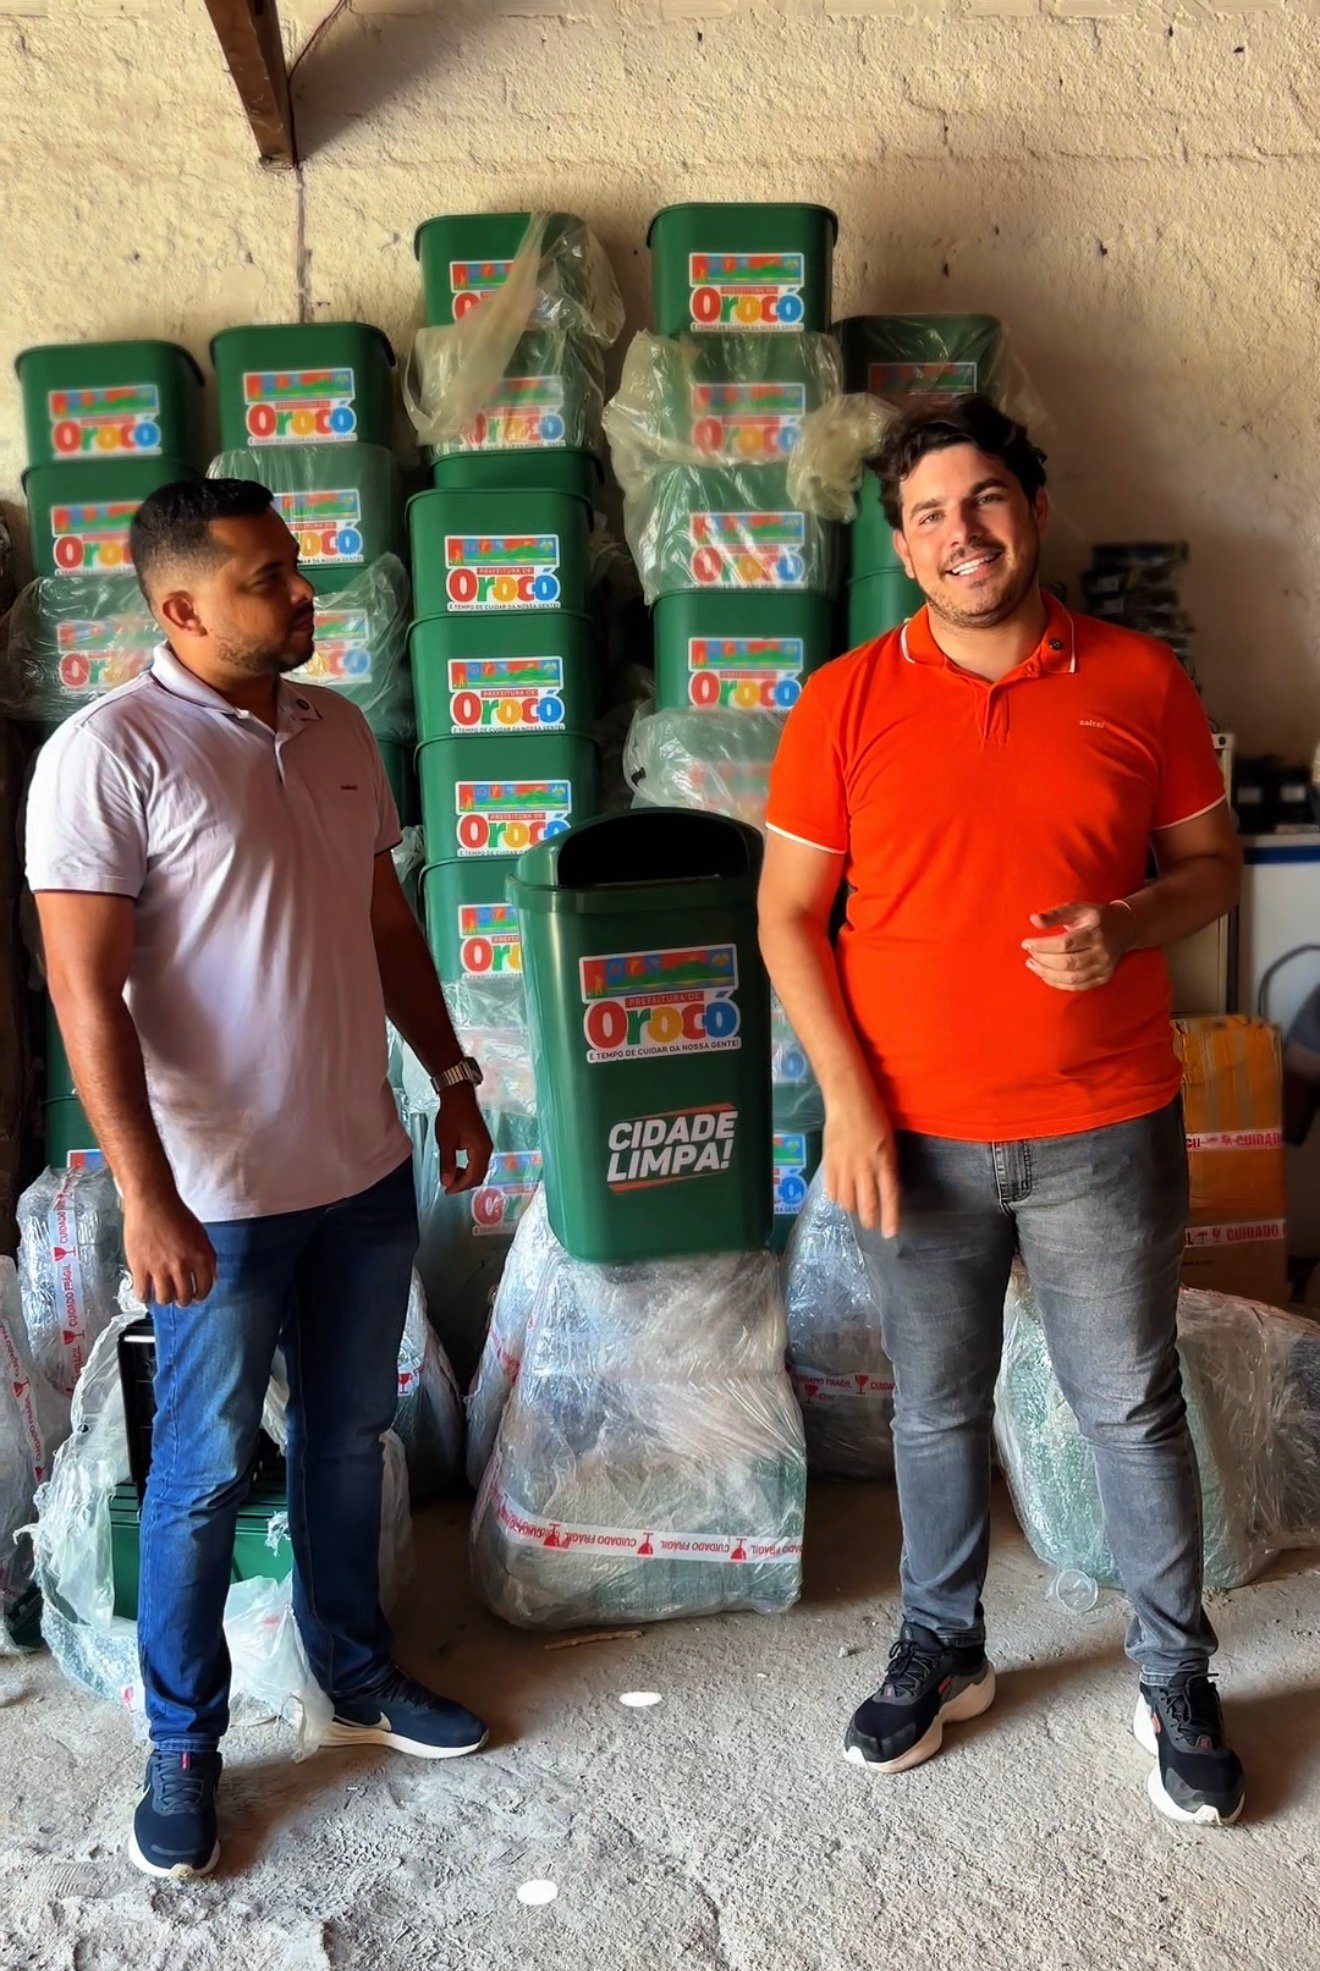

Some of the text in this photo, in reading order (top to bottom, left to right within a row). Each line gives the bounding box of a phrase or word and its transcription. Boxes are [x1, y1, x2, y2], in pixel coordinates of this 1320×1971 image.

[692, 287, 802, 323] Orocó
[54, 415, 159, 453] Orocó
[248, 399, 354, 437] Orocó
[449, 567, 558, 602] Orocó
[453, 689, 562, 725] Orocó
[691, 671, 801, 708] Orocó
[628, 992, 700, 1006] PREFEITURA DE
[587, 990, 737, 1049] Orocó
[596, 1050, 625, 1060] TEMPO
[626, 1049, 636, 1058] DE
[638, 1046, 668, 1056] CUIDAR
[669, 1045, 680, 1053] DA
[682, 1043, 710, 1052] NOSSA
[711, 1039, 739, 1049] GENTE!
[608, 1111, 738, 1151] CIDADE
[606, 1139, 734, 1182] LIMPA!
[1226, 1224, 1280, 1242] CUIDADO
[63, 1292, 78, 1328] CUIDADO
[565, 1532, 637, 1547] CUIDADO FRÁGIL
[660, 1540, 731, 1553] CUIDADO FRÁGIL
